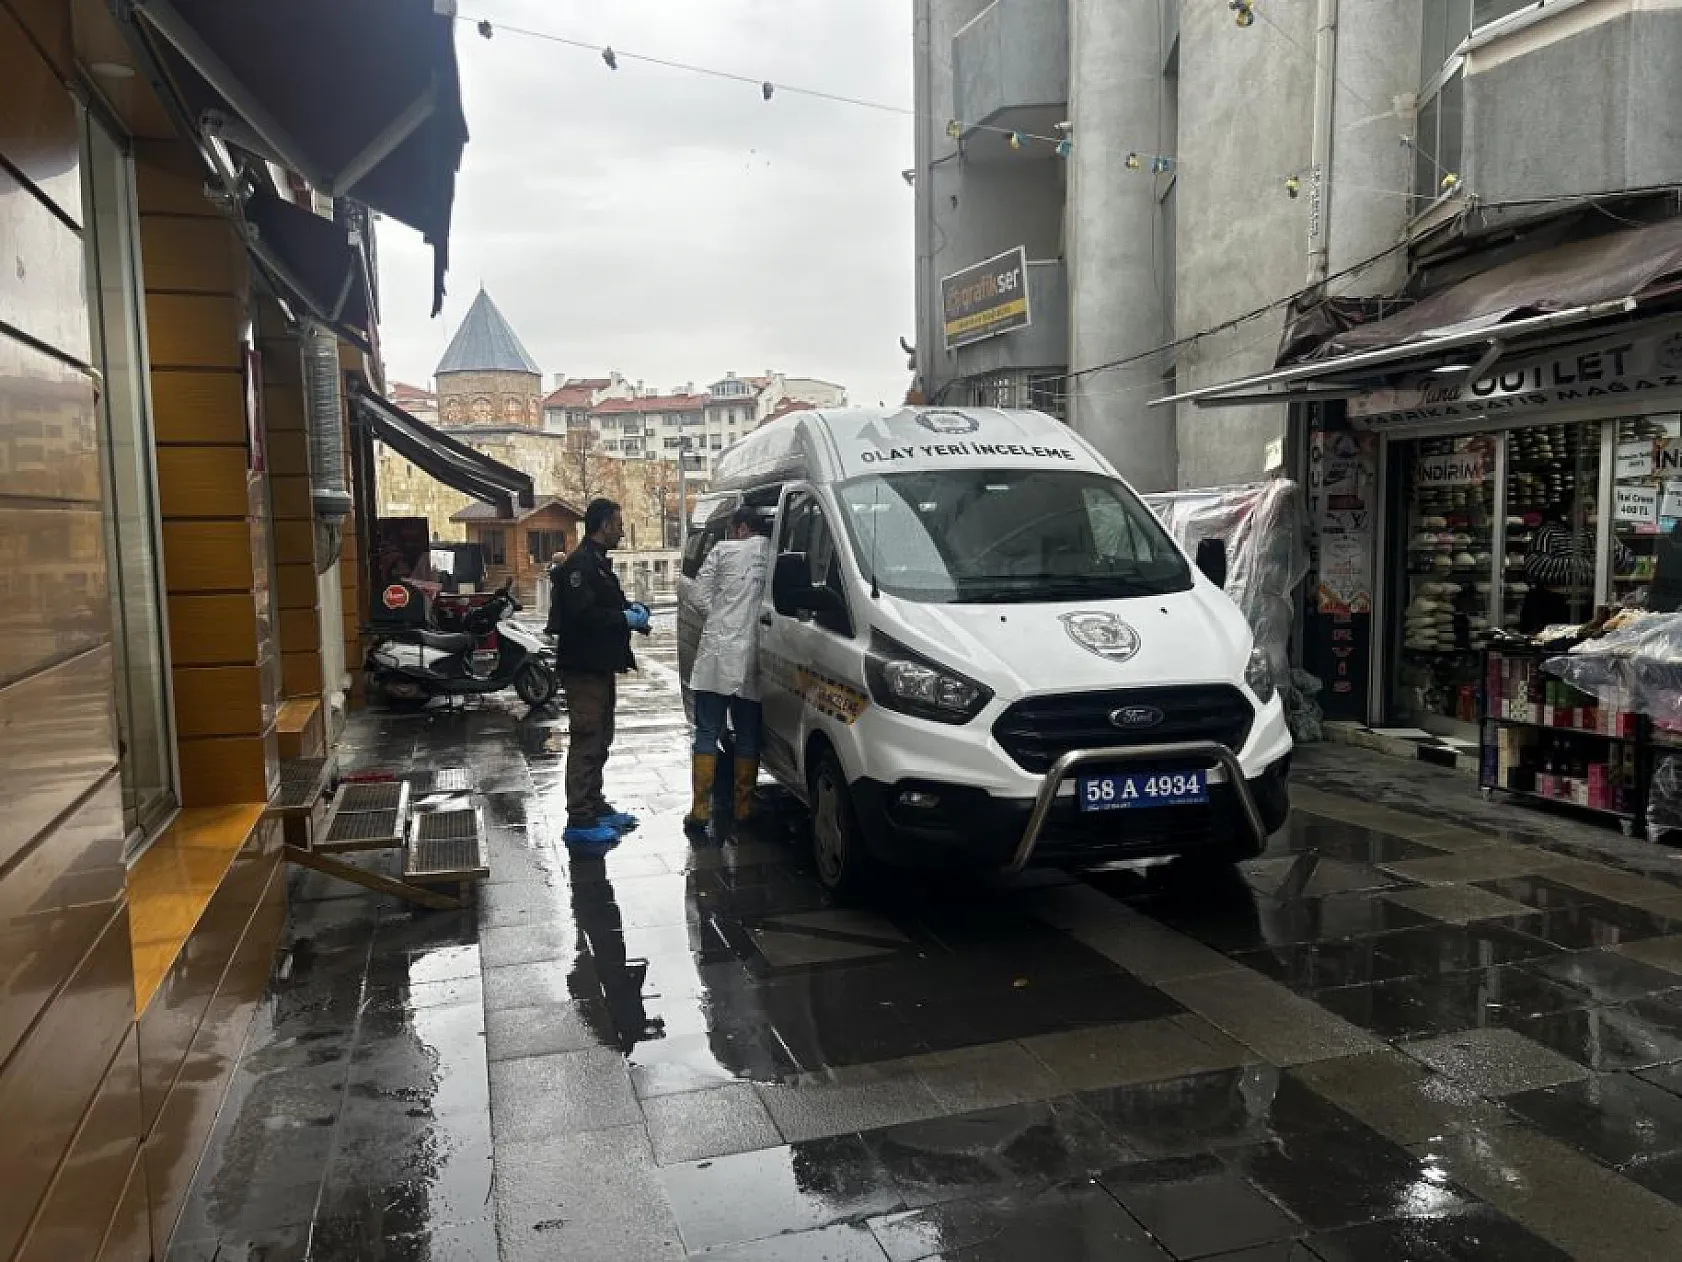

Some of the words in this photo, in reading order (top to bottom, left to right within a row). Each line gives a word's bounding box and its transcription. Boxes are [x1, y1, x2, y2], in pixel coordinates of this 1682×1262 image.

[861, 446, 914, 463] OLAY
[920, 441, 970, 458] YERİ
[971, 441, 1076, 461] İNCELEME
[1087, 779, 1115, 801] 58
[1121, 777, 1139, 799] A
[1144, 774, 1201, 798] 4934
